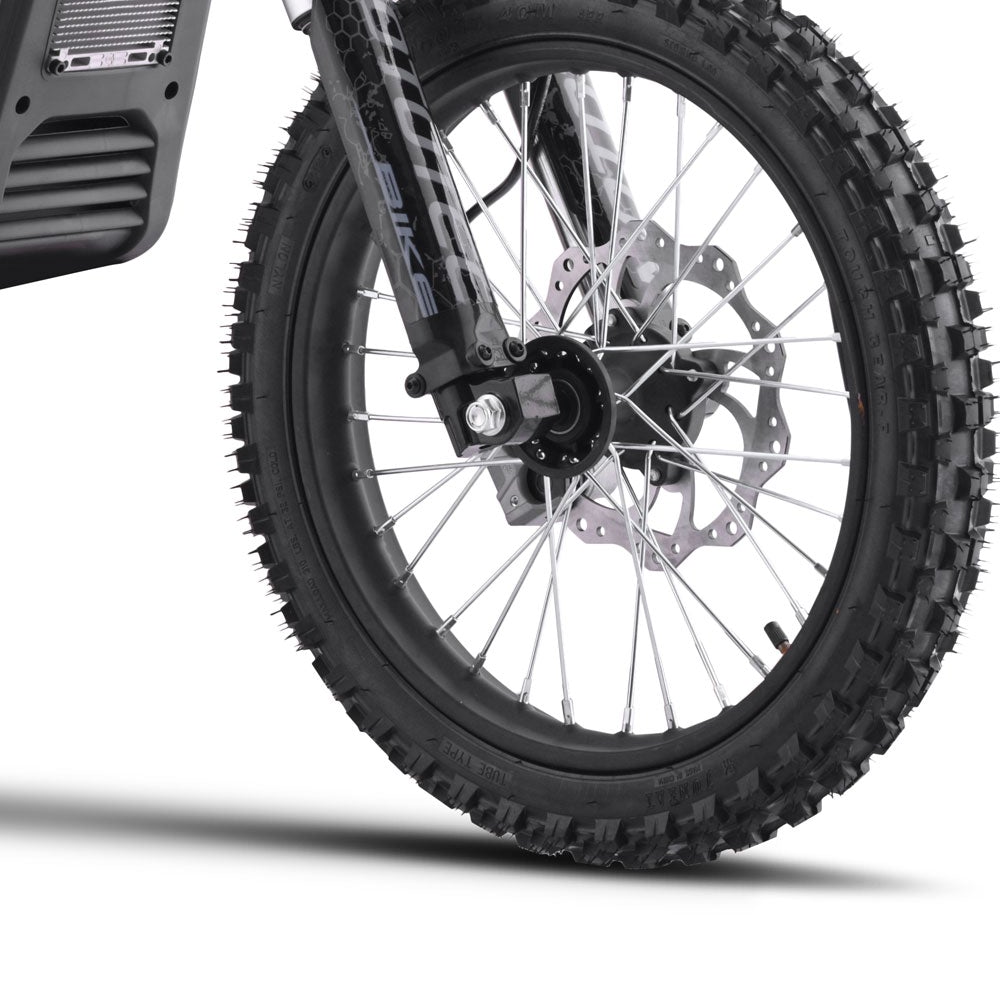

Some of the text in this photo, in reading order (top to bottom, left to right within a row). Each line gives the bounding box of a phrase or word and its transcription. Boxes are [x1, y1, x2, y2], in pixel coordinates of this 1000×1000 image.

[374, 160, 439, 318] BIKE
[442, 741, 506, 786] TUBE TYPE
